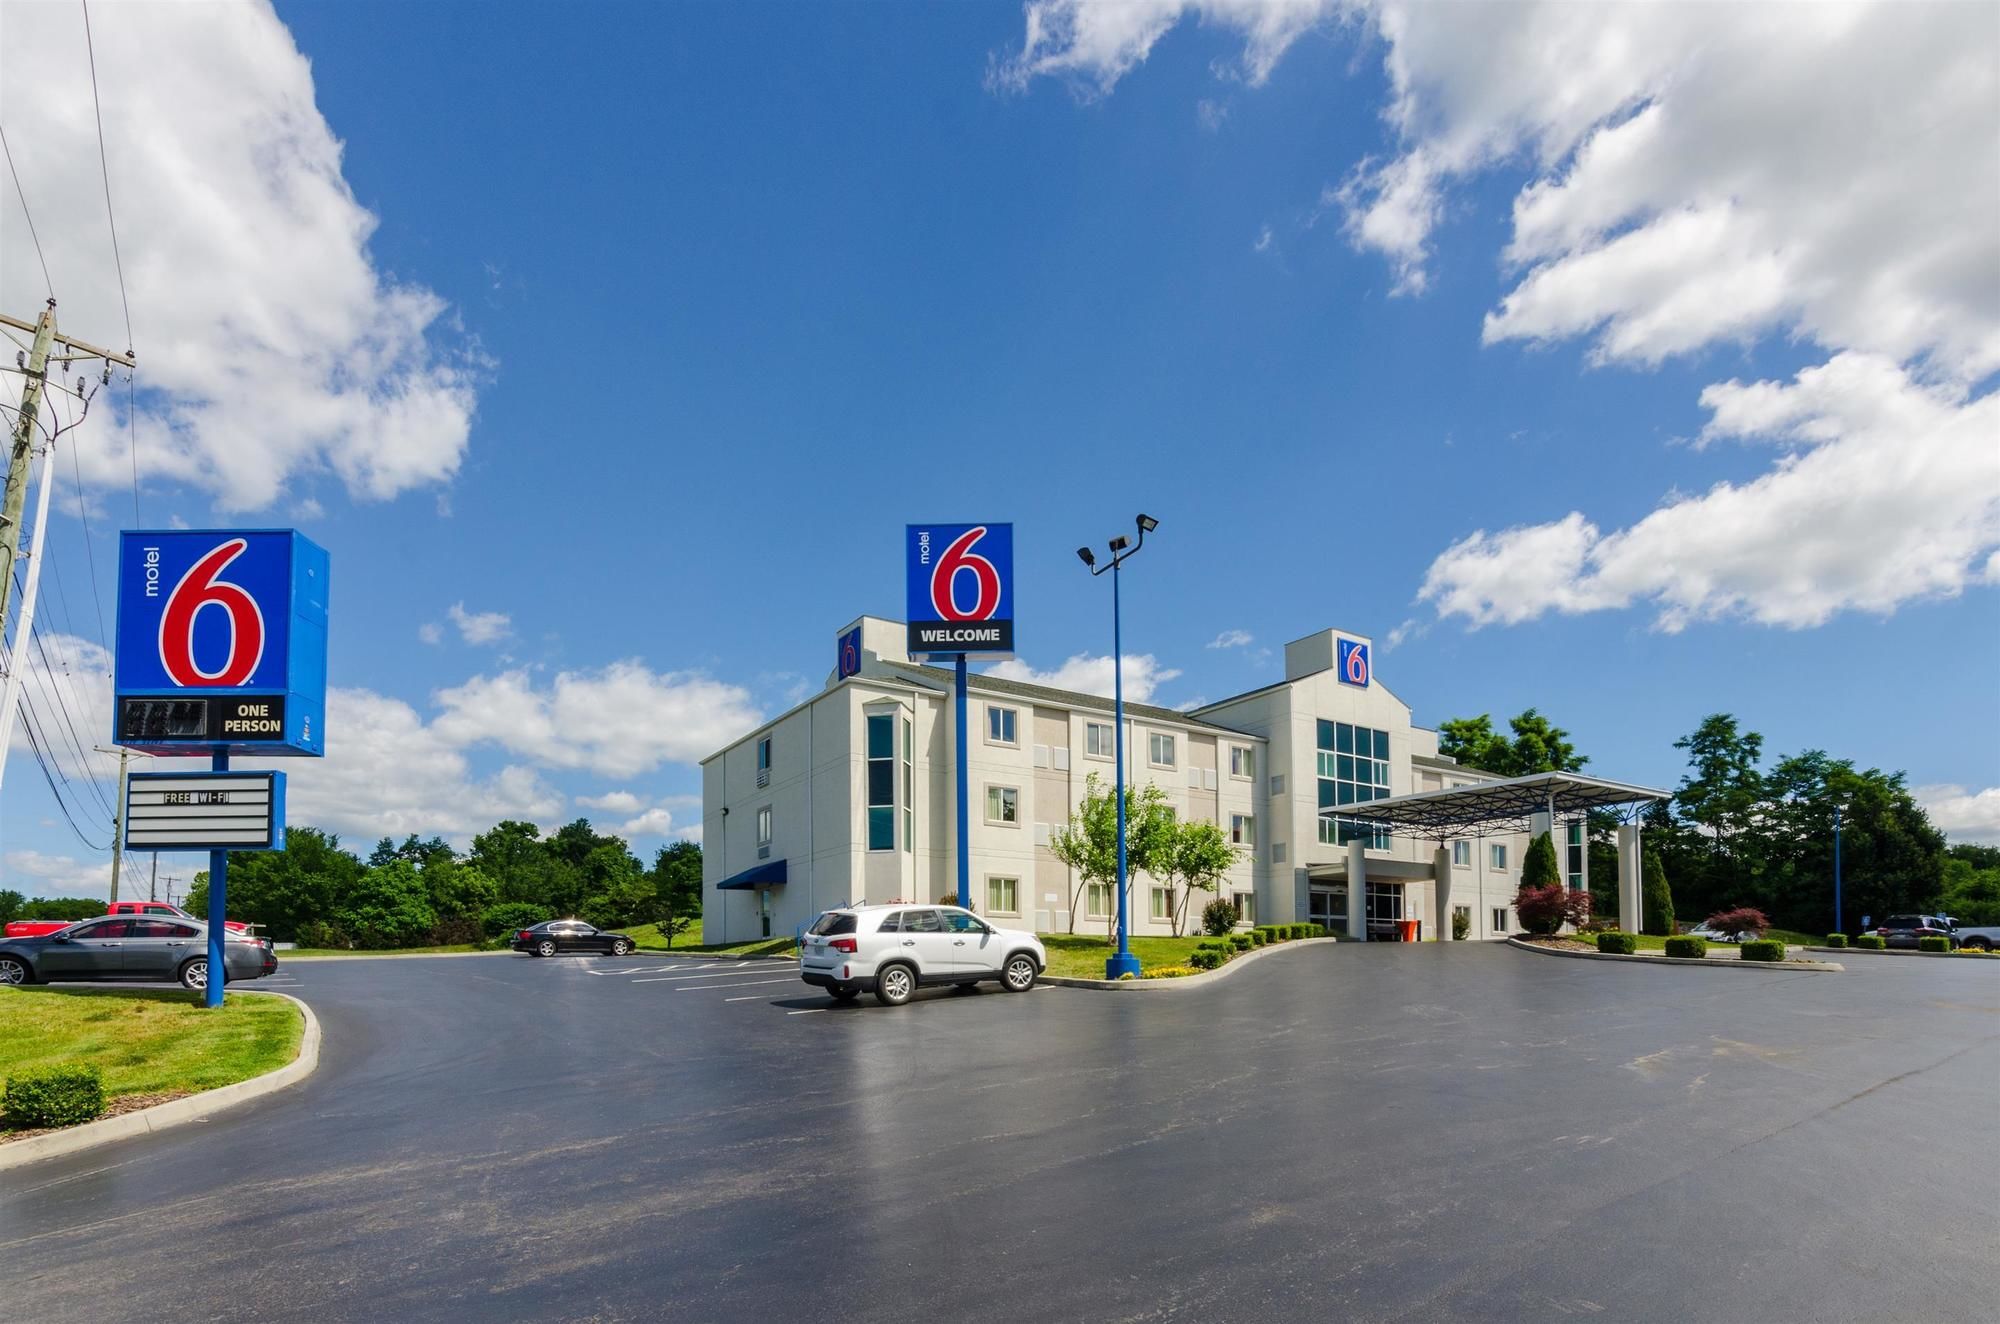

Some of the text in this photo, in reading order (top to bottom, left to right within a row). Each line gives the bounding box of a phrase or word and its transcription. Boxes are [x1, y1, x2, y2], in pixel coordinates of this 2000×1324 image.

[918, 526, 1001, 621] motel 6
[143, 537, 265, 687] motel 6
[920, 628, 1000, 643] WELCOME
[842, 632, 856, 677] 6
[1347, 644, 1367, 685] 6
[237, 704, 269, 717] ONE
[224, 719, 281, 733] PERSON
[164, 792, 190, 804] FREE
